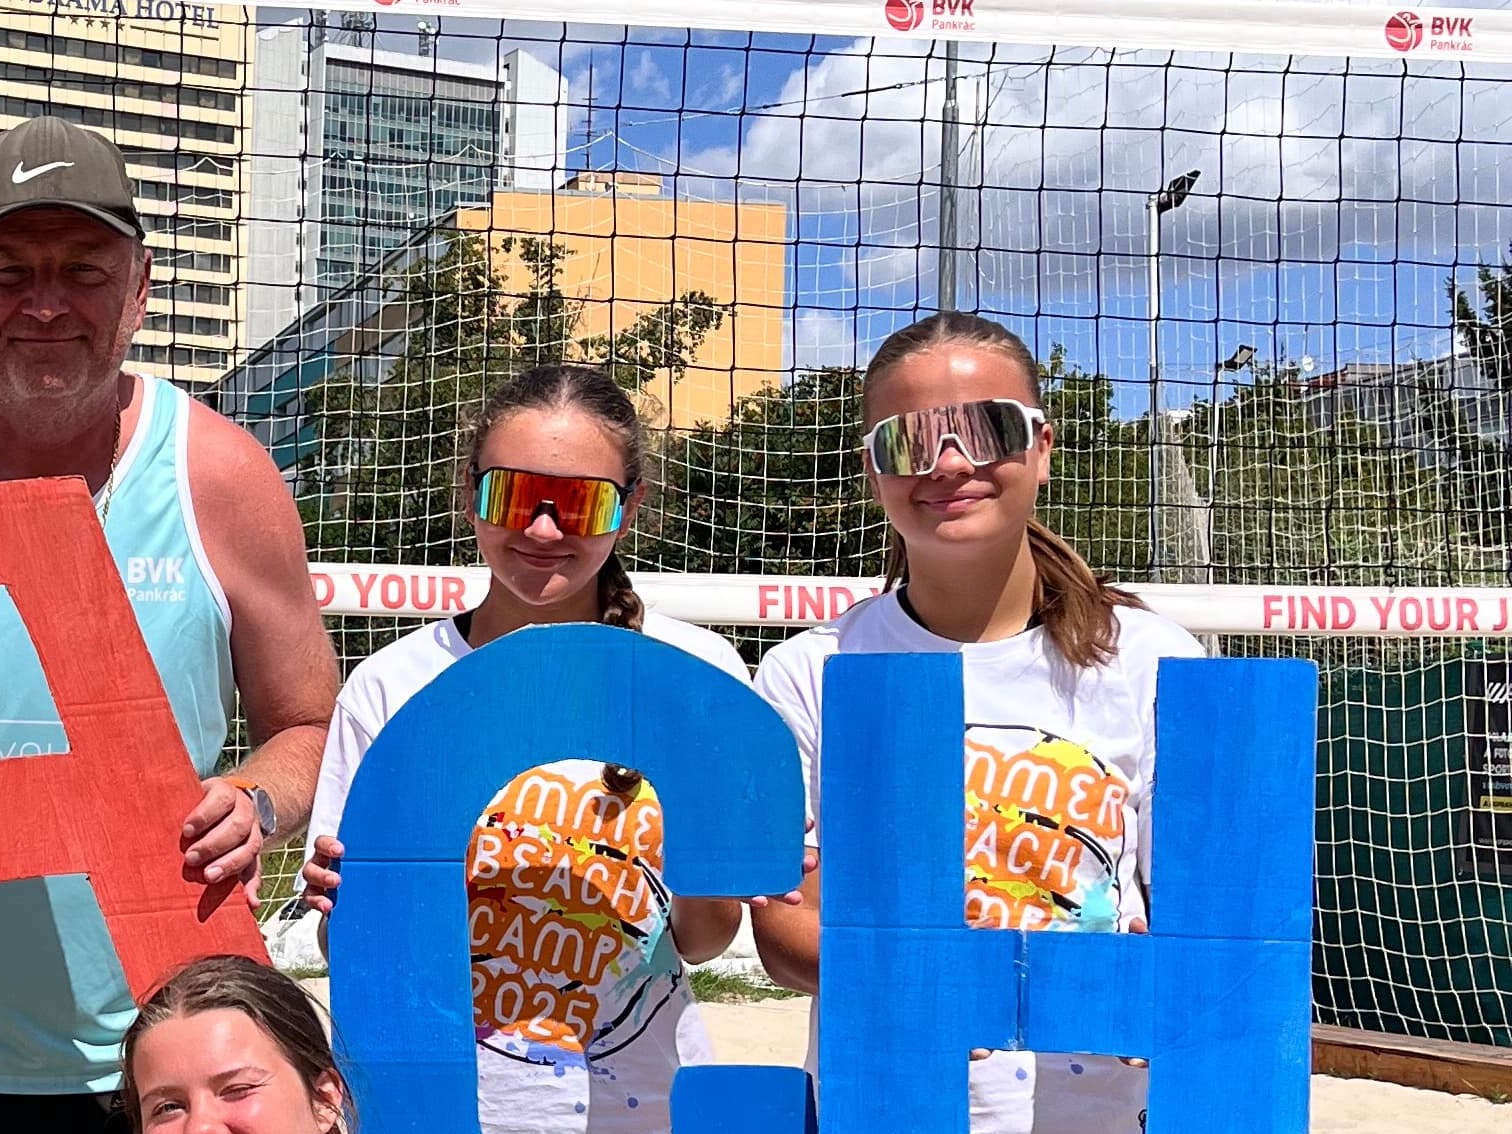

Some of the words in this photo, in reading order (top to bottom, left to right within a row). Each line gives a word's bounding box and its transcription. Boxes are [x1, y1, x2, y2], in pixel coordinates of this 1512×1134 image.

[137, 1, 219, 29] HOTEL
[932, 0, 974, 16] BVK
[1431, 16, 1473, 37] BVK
[127, 556, 185, 584] BVK
[351, 573, 467, 611] YOUR
[759, 584, 856, 620] FIND
[1263, 594, 1357, 630] FIND
[1369, 596, 1480, 631] YOUR
[472, 834, 646, 917] BEACH
[470, 905, 617, 980] CAMP
